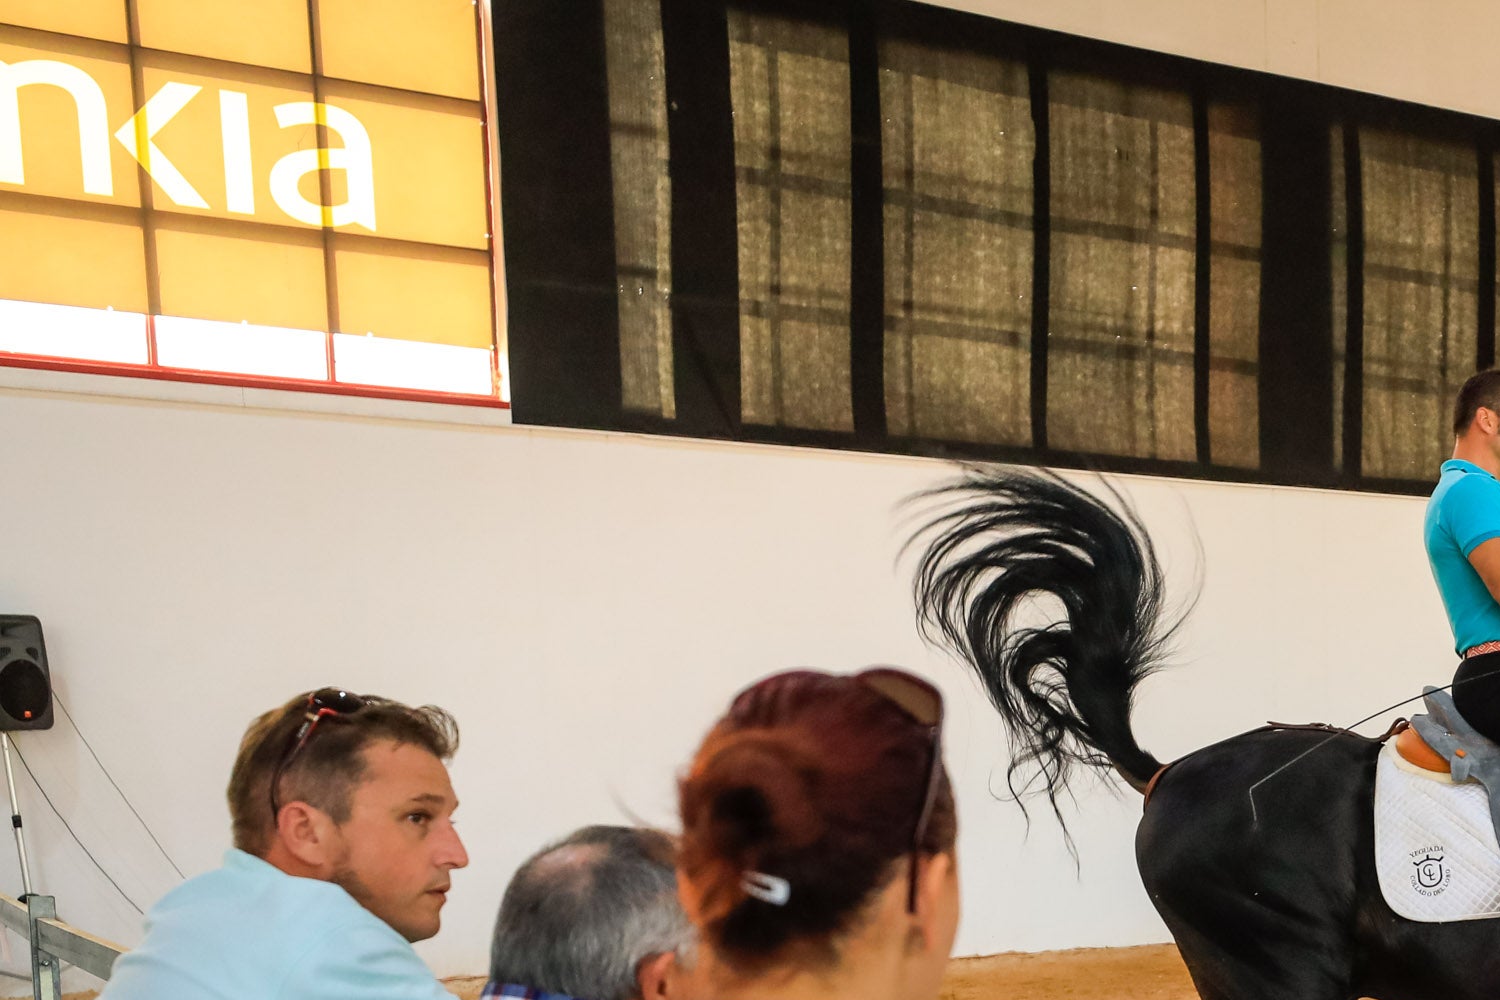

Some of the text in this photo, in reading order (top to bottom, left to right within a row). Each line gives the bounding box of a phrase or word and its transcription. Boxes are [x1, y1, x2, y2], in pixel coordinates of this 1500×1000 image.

[1409, 846, 1444, 857] YEGUADA
[1410, 875, 1432, 896] COLLADO
[1433, 887, 1445, 896] DEL
